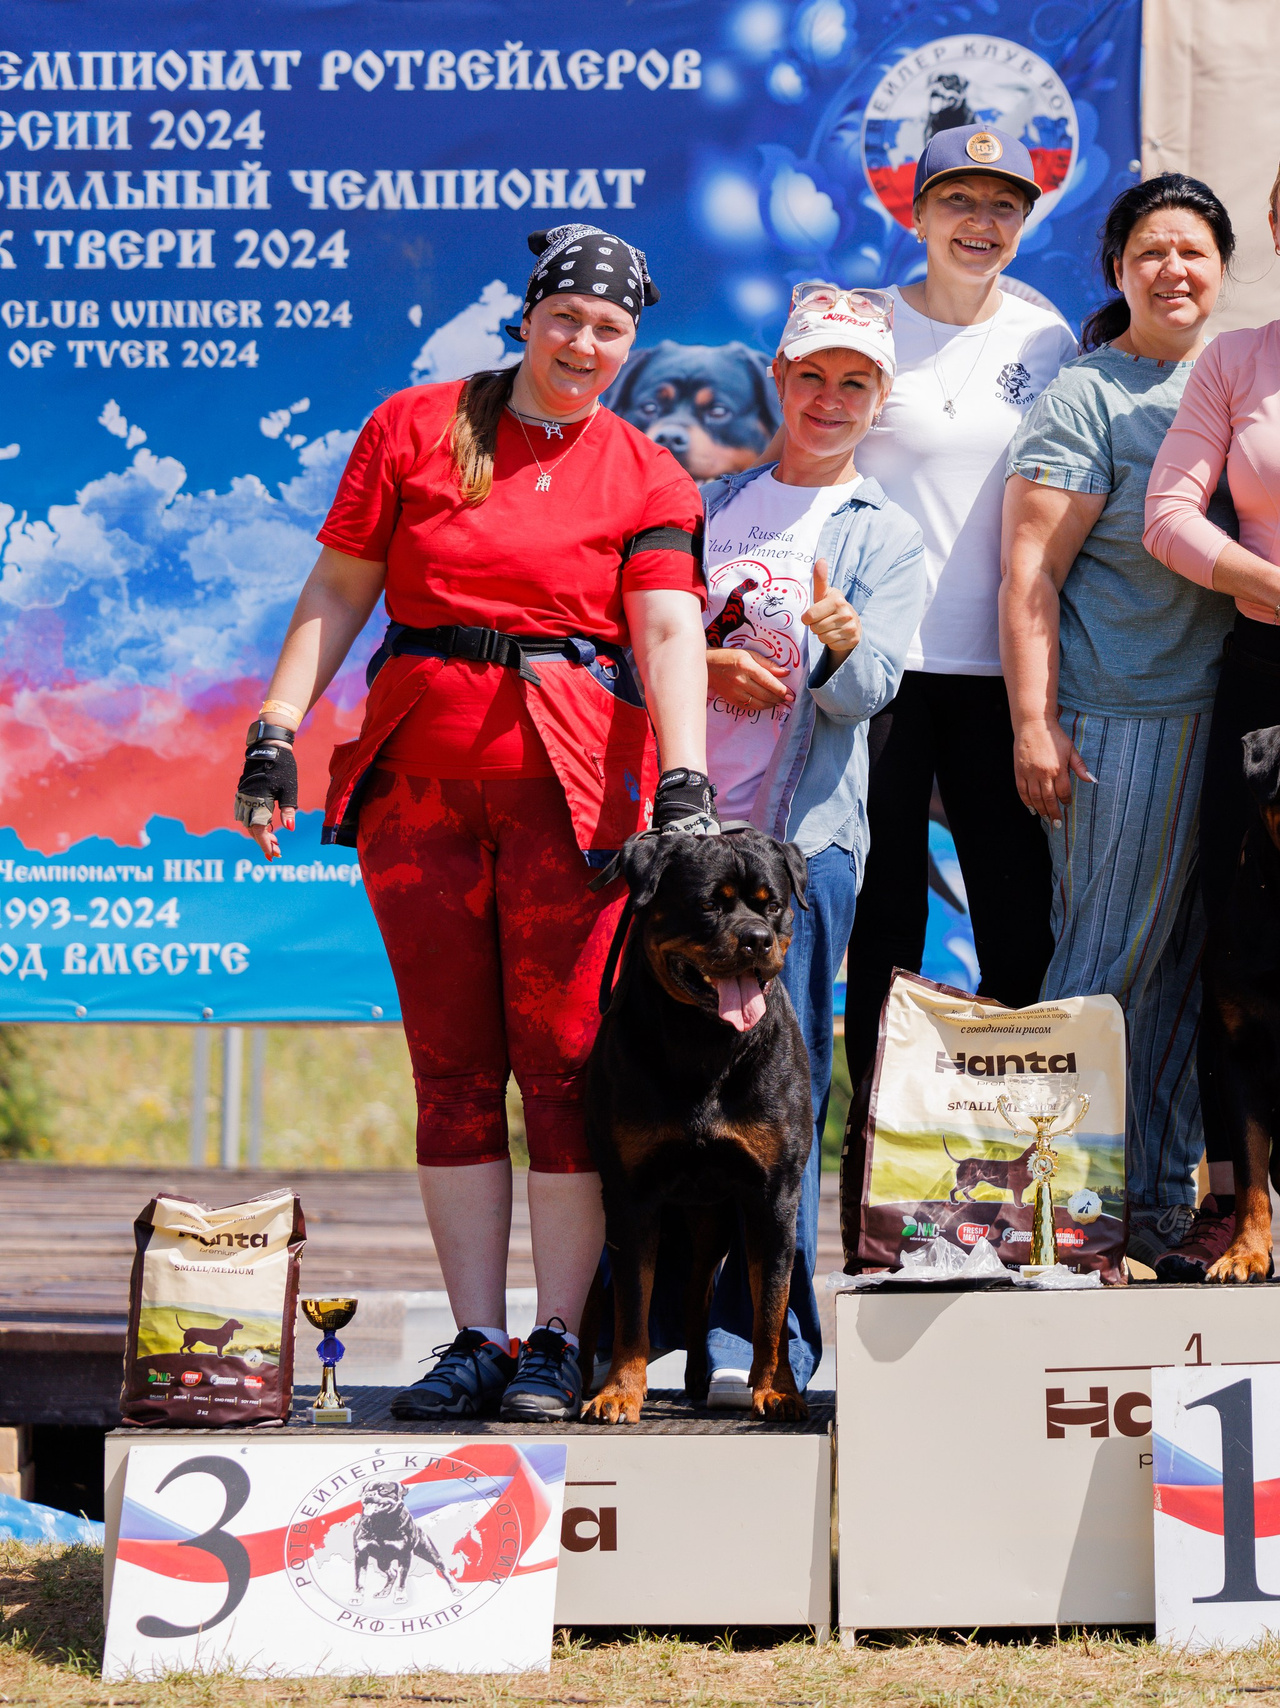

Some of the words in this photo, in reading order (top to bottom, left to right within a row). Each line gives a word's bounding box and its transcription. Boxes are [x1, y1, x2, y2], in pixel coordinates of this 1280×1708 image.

[0, 49, 301, 91] ЕМПИОНАТ
[320, 41, 702, 92] РОТВЕЙЛЕРОВ
[963, 42, 1038, 75] КЛУБ
[149, 109, 265, 151] 2024
[0, 162, 271, 211] НАЛЬНЫЙ
[291, 168, 646, 211] ЧЕМПИОНАТ
[34, 229, 216, 270] ТВЕРИ
[234, 229, 350, 269] 2024
[1, 299, 100, 329] CLUB
[111, 299, 266, 329] WINNER
[275, 299, 353, 329] 2024
[8, 339, 56, 369] OF
[67, 339, 170, 369] TVER
[181, 339, 260, 369] 2024
[748, 525, 794, 543] Russia
[713, 696, 746, 722] Cup
[242, 799, 265, 808] HOCK
[683, 816, 709, 832] SHOC
[0, 859, 153, 883] Чемпионаты
[162, 859, 225, 883] НКП
[233, 859, 362, 887] Ротвейлер
[0, 896, 181, 930] 993-2024
[0, 942, 49, 981] ОД
[61, 942, 250, 976] ВМЕСТЕ
[967, 1024, 1015, 1034] говядиной
[1022, 1026, 1051, 1036] рисом
[935, 1051, 1077, 1076] Hanta
[917, 1222, 940, 1237] NWC
[963, 1226, 984, 1235] FRESH
[963, 1234, 980, 1242] MEAT
[174, 1263, 255, 1276] SMALL/MEDIUM
[287, 1457, 386, 1589] РОТВЕЙЛЕР
[404, 1455, 478, 1484] КЛУБ
[487, 1487, 519, 1586] РОССИИ
[136, 1455, 251, 1639] 3
[336, 1603, 466, 1634] РКФ-НКПР
